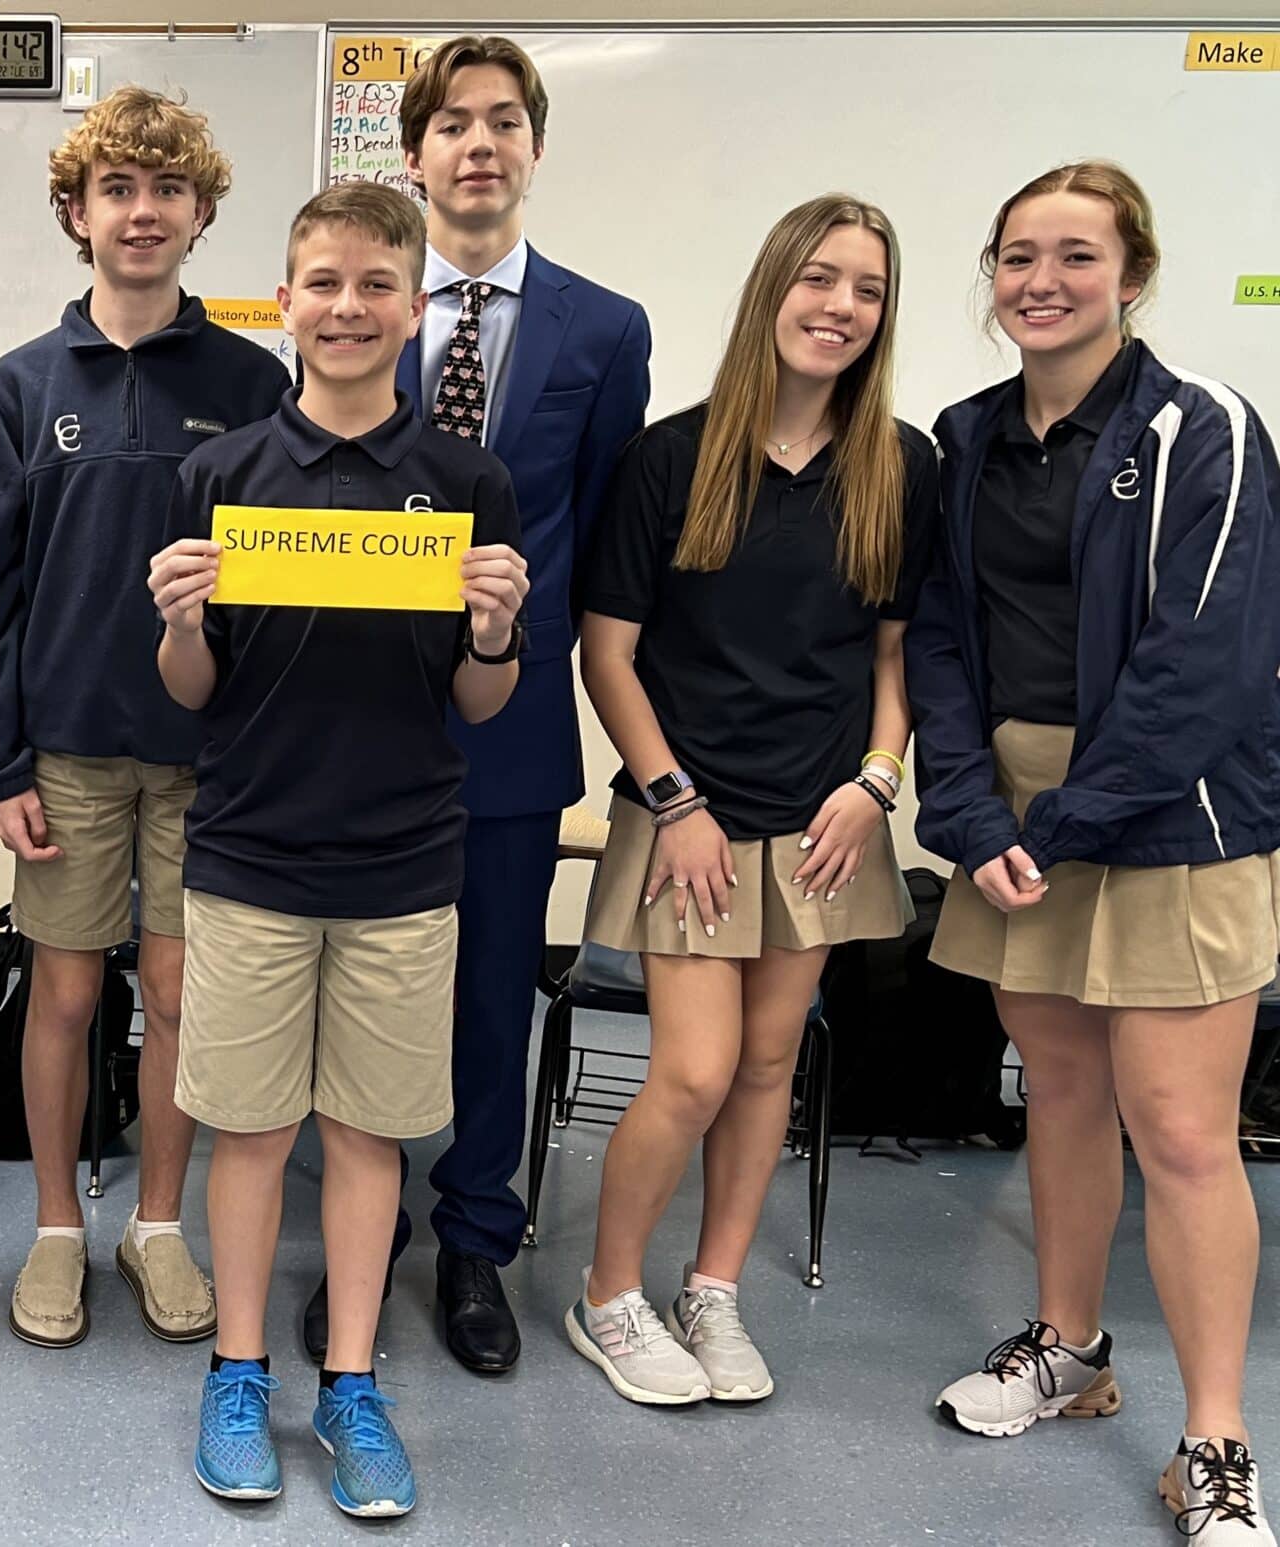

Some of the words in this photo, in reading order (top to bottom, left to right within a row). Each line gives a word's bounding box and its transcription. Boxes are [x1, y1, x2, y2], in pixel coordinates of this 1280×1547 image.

[342, 41, 383, 76] 8th
[1197, 41, 1264, 64] Make
[354, 134, 399, 153] Decodi
[374, 170, 410, 186] Const
[1243, 285, 1269, 298] U.S.
[208, 309, 250, 323] History
[253, 310, 281, 322] Date
[224, 528, 353, 554] SUPREME
[362, 533, 457, 557] COURT
